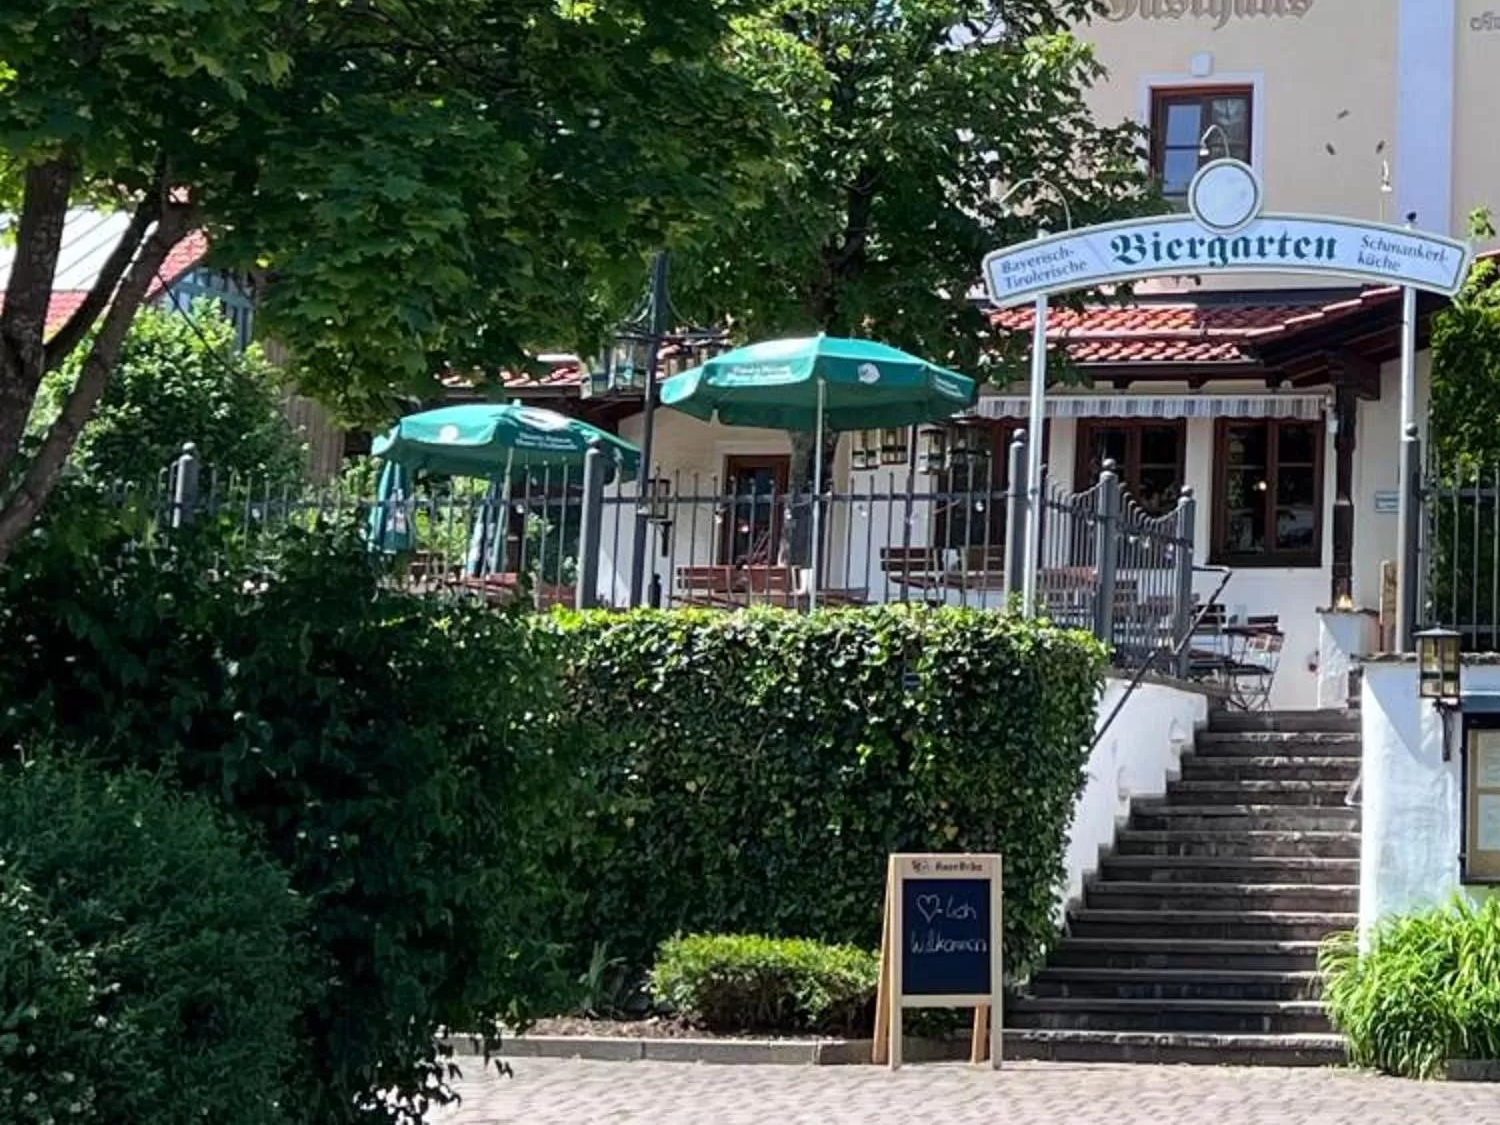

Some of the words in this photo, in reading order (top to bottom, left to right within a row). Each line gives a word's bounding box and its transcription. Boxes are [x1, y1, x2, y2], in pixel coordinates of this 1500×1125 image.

[1110, 231, 1337, 267] Biergarten
[1358, 251, 1401, 271] küche
[1006, 261, 1087, 289] Tirolerische
